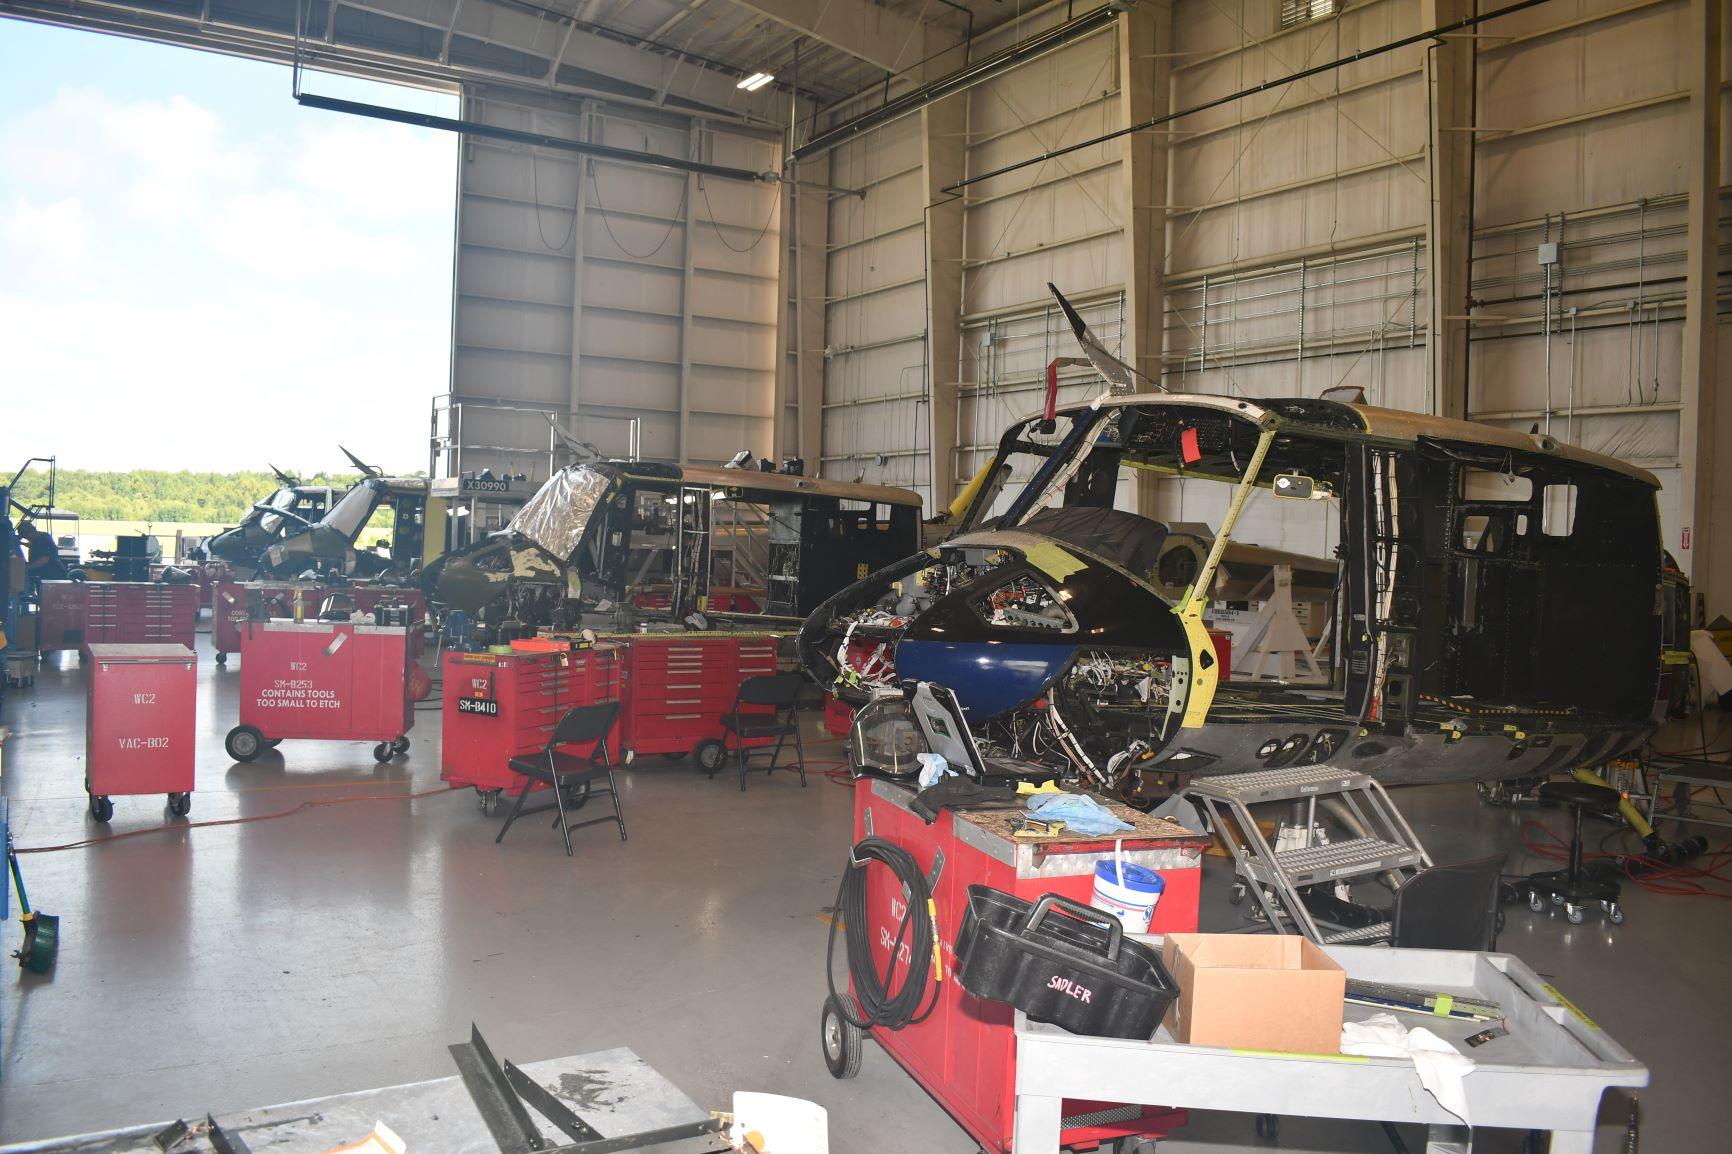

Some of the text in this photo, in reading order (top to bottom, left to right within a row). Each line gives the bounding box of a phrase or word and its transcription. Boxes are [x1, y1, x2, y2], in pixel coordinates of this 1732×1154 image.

[467, 481, 506, 491] X30990
[290, 662, 307, 671] WC2
[472, 678, 488, 690] WC2
[134, 693, 156, 704] WC2
[261, 689, 335, 698] CONTAINS TOOLS
[257, 699, 340, 708] TOO SMALL TO ETCH
[459, 699, 497, 714] SM-B410
[119, 737, 169, 749] VAC-B02
[1046, 975, 1092, 1004] SADLER
